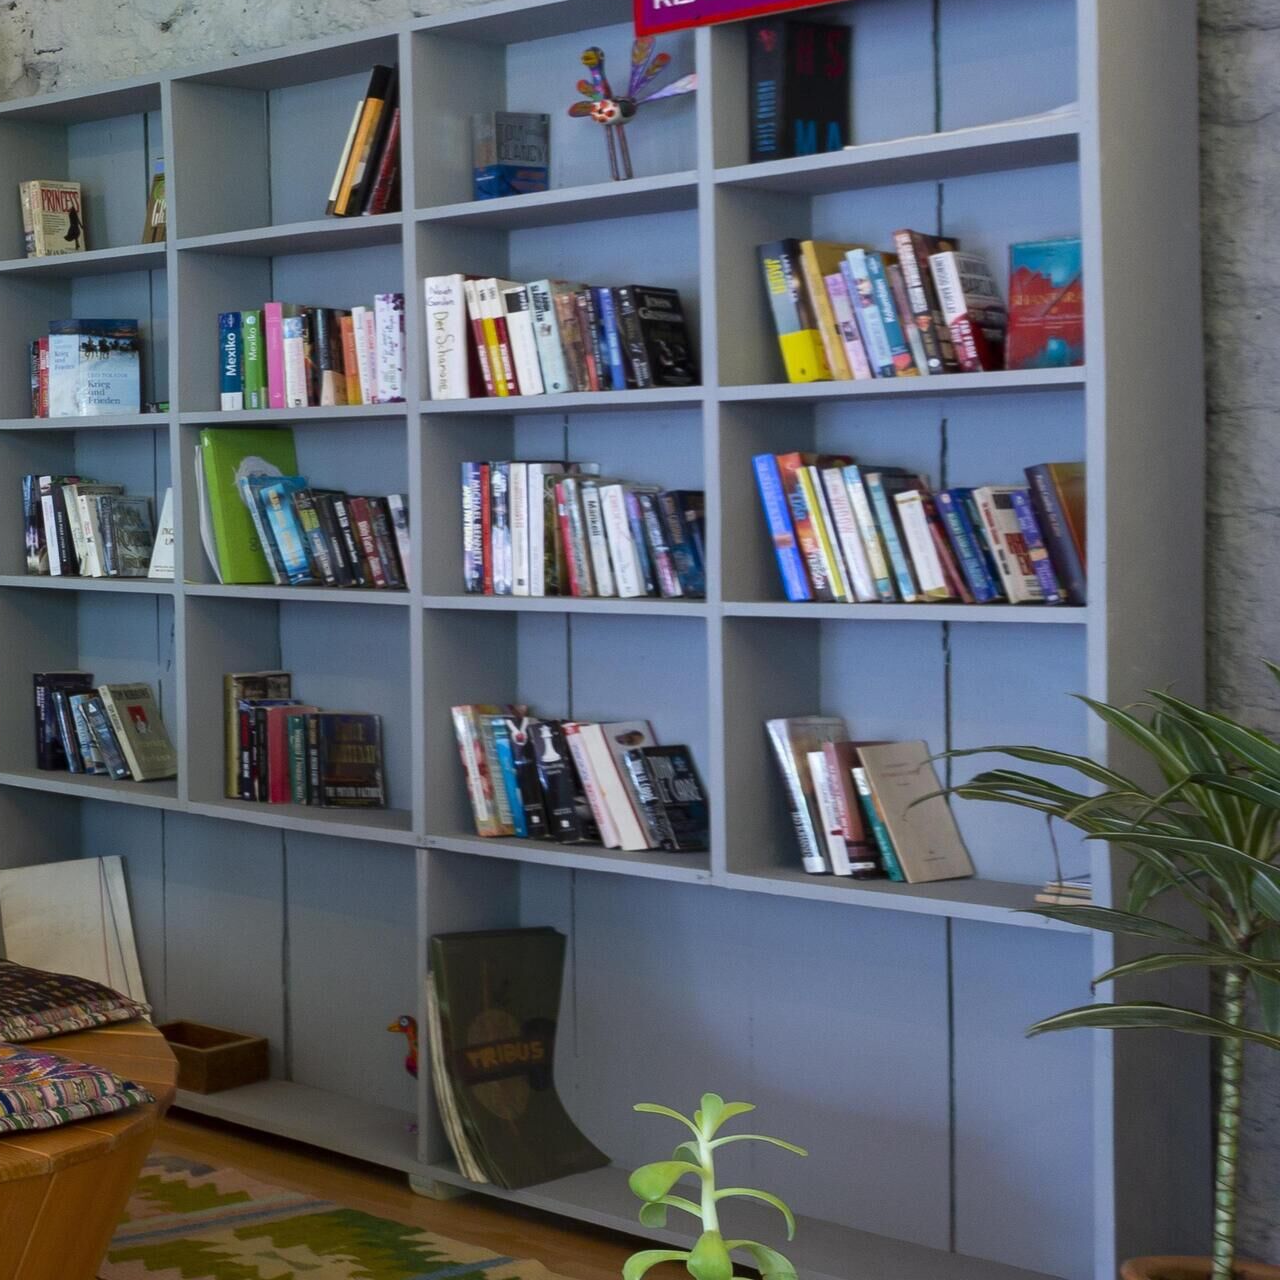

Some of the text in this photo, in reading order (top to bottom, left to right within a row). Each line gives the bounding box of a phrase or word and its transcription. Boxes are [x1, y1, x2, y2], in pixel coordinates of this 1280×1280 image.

[41, 189, 80, 213] PRINCESS
[224, 332, 238, 378] Mexiko
[248, 326, 259, 362] Mexiko
[433, 311, 455, 393] Der Schamane
[964, 336, 976, 358] FROM
[87, 380, 111, 389] Krieg
[87, 397, 121, 405] Frieden
[471, 479, 481, 519] MICHAEL
[589, 500, 601, 536] Mankell
[472, 523, 482, 566] BENNETT
[802, 537, 825, 590] PATTERSON
[466, 1041, 544, 1068] TRIBUS
